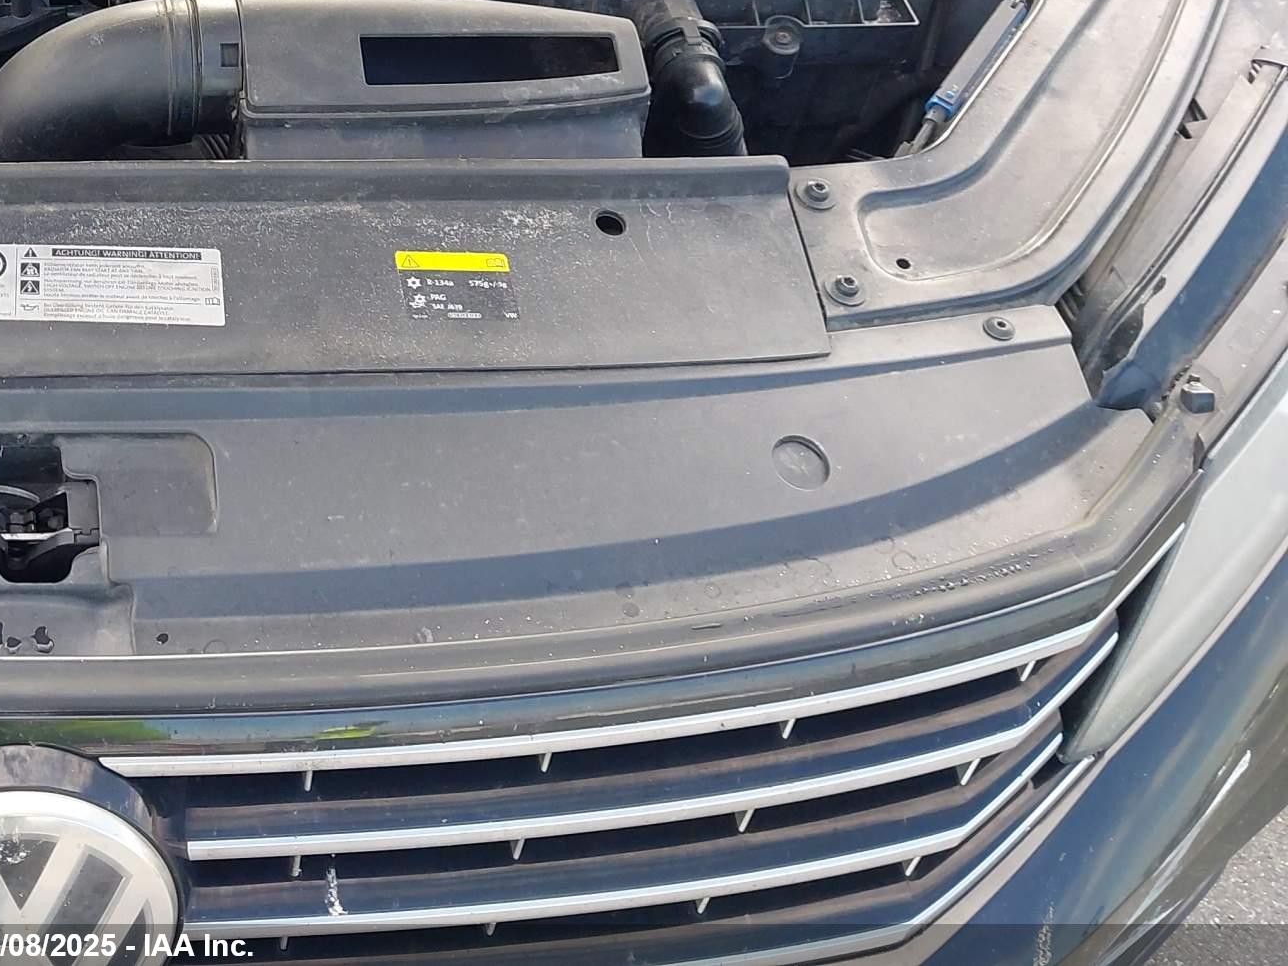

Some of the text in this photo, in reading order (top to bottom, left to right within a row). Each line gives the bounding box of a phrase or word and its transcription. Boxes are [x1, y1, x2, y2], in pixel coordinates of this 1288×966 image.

[102, 250, 147, 258] WARNING!
[149, 251, 200, 259] ATTENTION!
[430, 293, 447, 301] PAG
